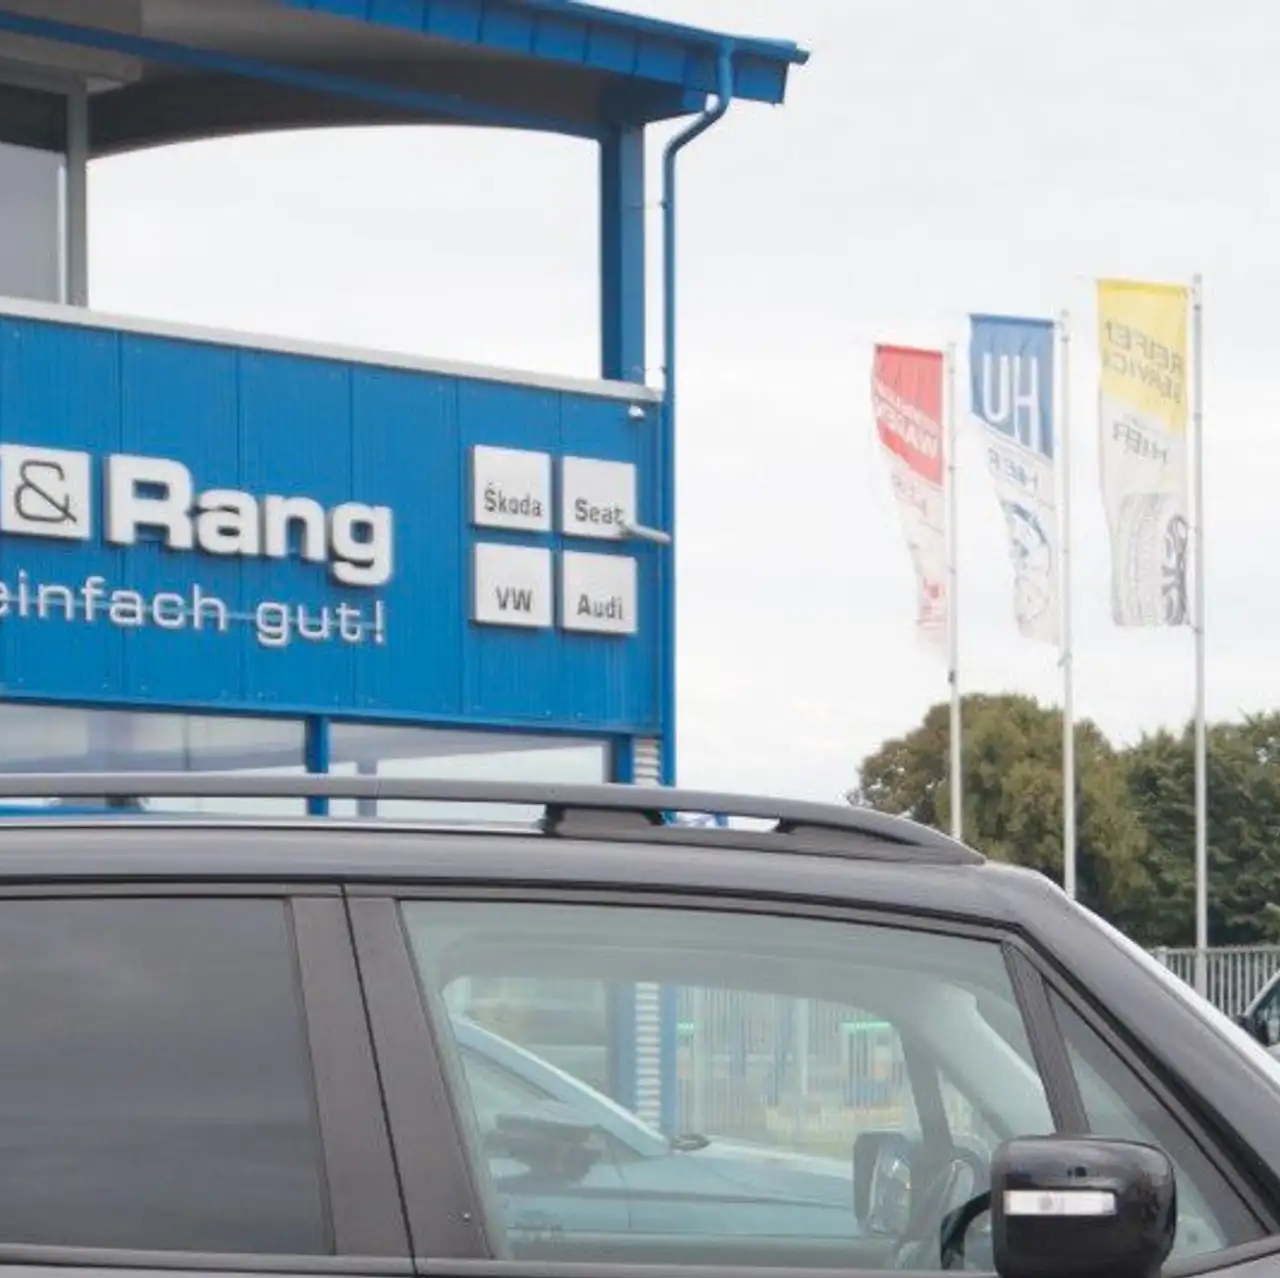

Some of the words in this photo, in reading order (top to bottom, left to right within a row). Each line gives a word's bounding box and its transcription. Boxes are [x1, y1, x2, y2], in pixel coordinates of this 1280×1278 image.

[13, 459, 78, 524] &
[104, 453, 394, 586] Rang
[574, 497, 624, 526] Seat
[495, 584, 533, 613] VW
[576, 594, 624, 621] Audi
[255, 599, 384, 647] gut!
